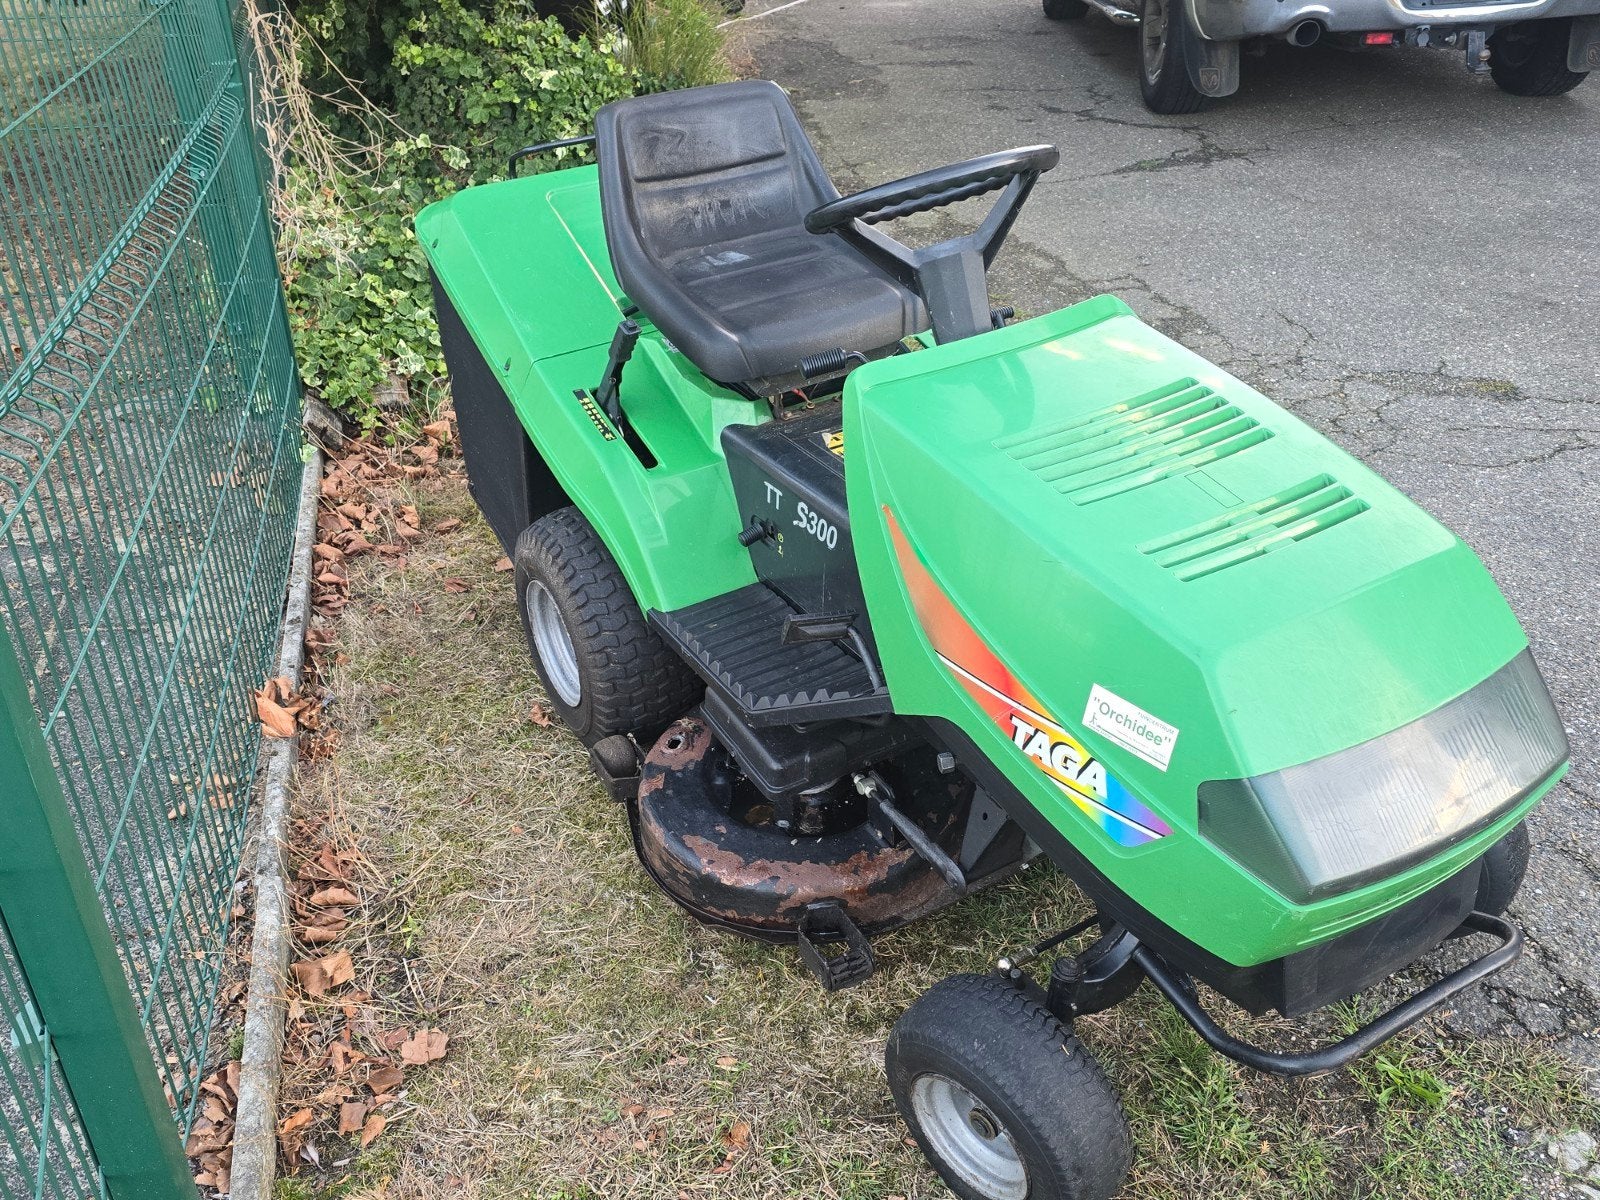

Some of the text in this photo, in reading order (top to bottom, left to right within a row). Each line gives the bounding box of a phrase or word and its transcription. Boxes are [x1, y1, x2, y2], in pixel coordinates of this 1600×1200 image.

[765, 482, 837, 549] TT S300
[1010, 713, 1108, 799] TAGA
